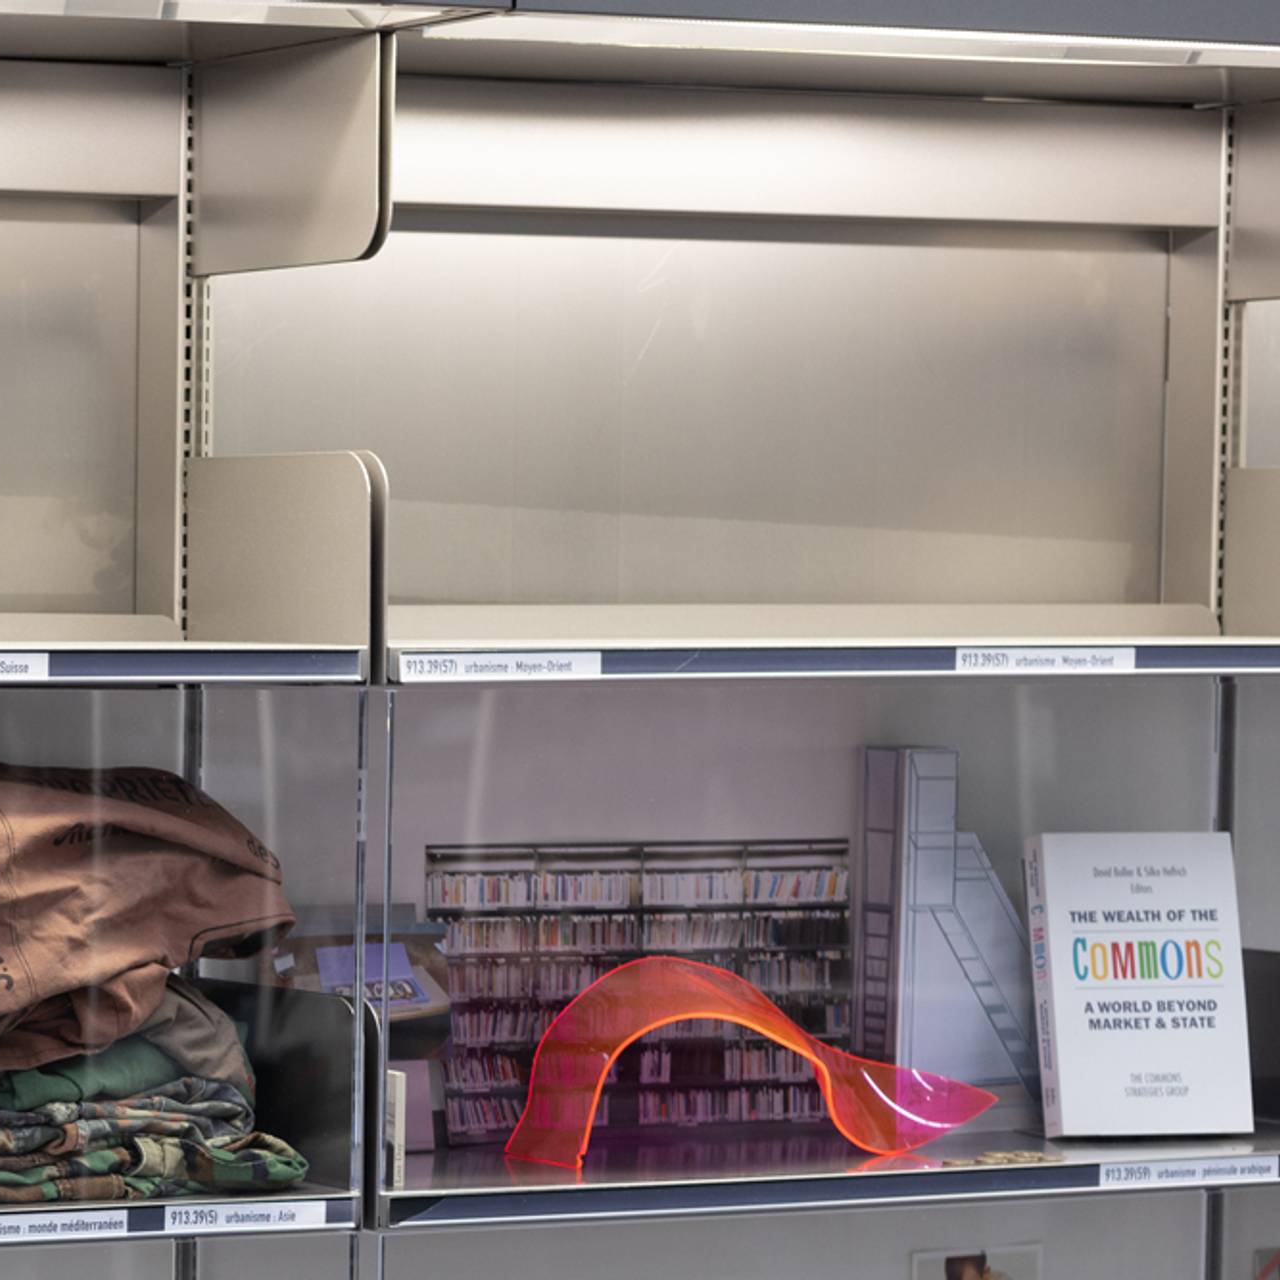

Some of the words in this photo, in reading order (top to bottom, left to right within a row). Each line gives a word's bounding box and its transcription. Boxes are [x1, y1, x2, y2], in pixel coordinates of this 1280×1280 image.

[0, 661, 29, 674] Suisse
[464, 660, 508, 673] urbanisme
[516, 660, 572, 675] Moyen-Orient
[1016, 655, 1055, 666] urbanisme
[1070, 910, 1098, 923] THE
[1102, 910, 1160, 922] WEALTH
[1166, 909, 1186, 921] OF
[1191, 908, 1218, 921] THE
[1084, 1002, 1094, 1014] A
[1098, 1001, 1152, 1013] WORLD
[1157, 1000, 1218, 1012] BEYOND
[1089, 1018, 1151, 1030] MARKET
[1155, 1018, 1166, 1030] &
[1171, 1017, 1216, 1029] STATE
[1157, 1168, 1196, 1179] urbanisme
[170, 1208, 218, 1226] 913.39(5)
[225, 1211, 271, 1224] urbanisme
[279, 1210, 296, 1222] Asie
[28, 1220, 58, 1234] monde
[60, 1217, 124, 1233] méditerranéen
